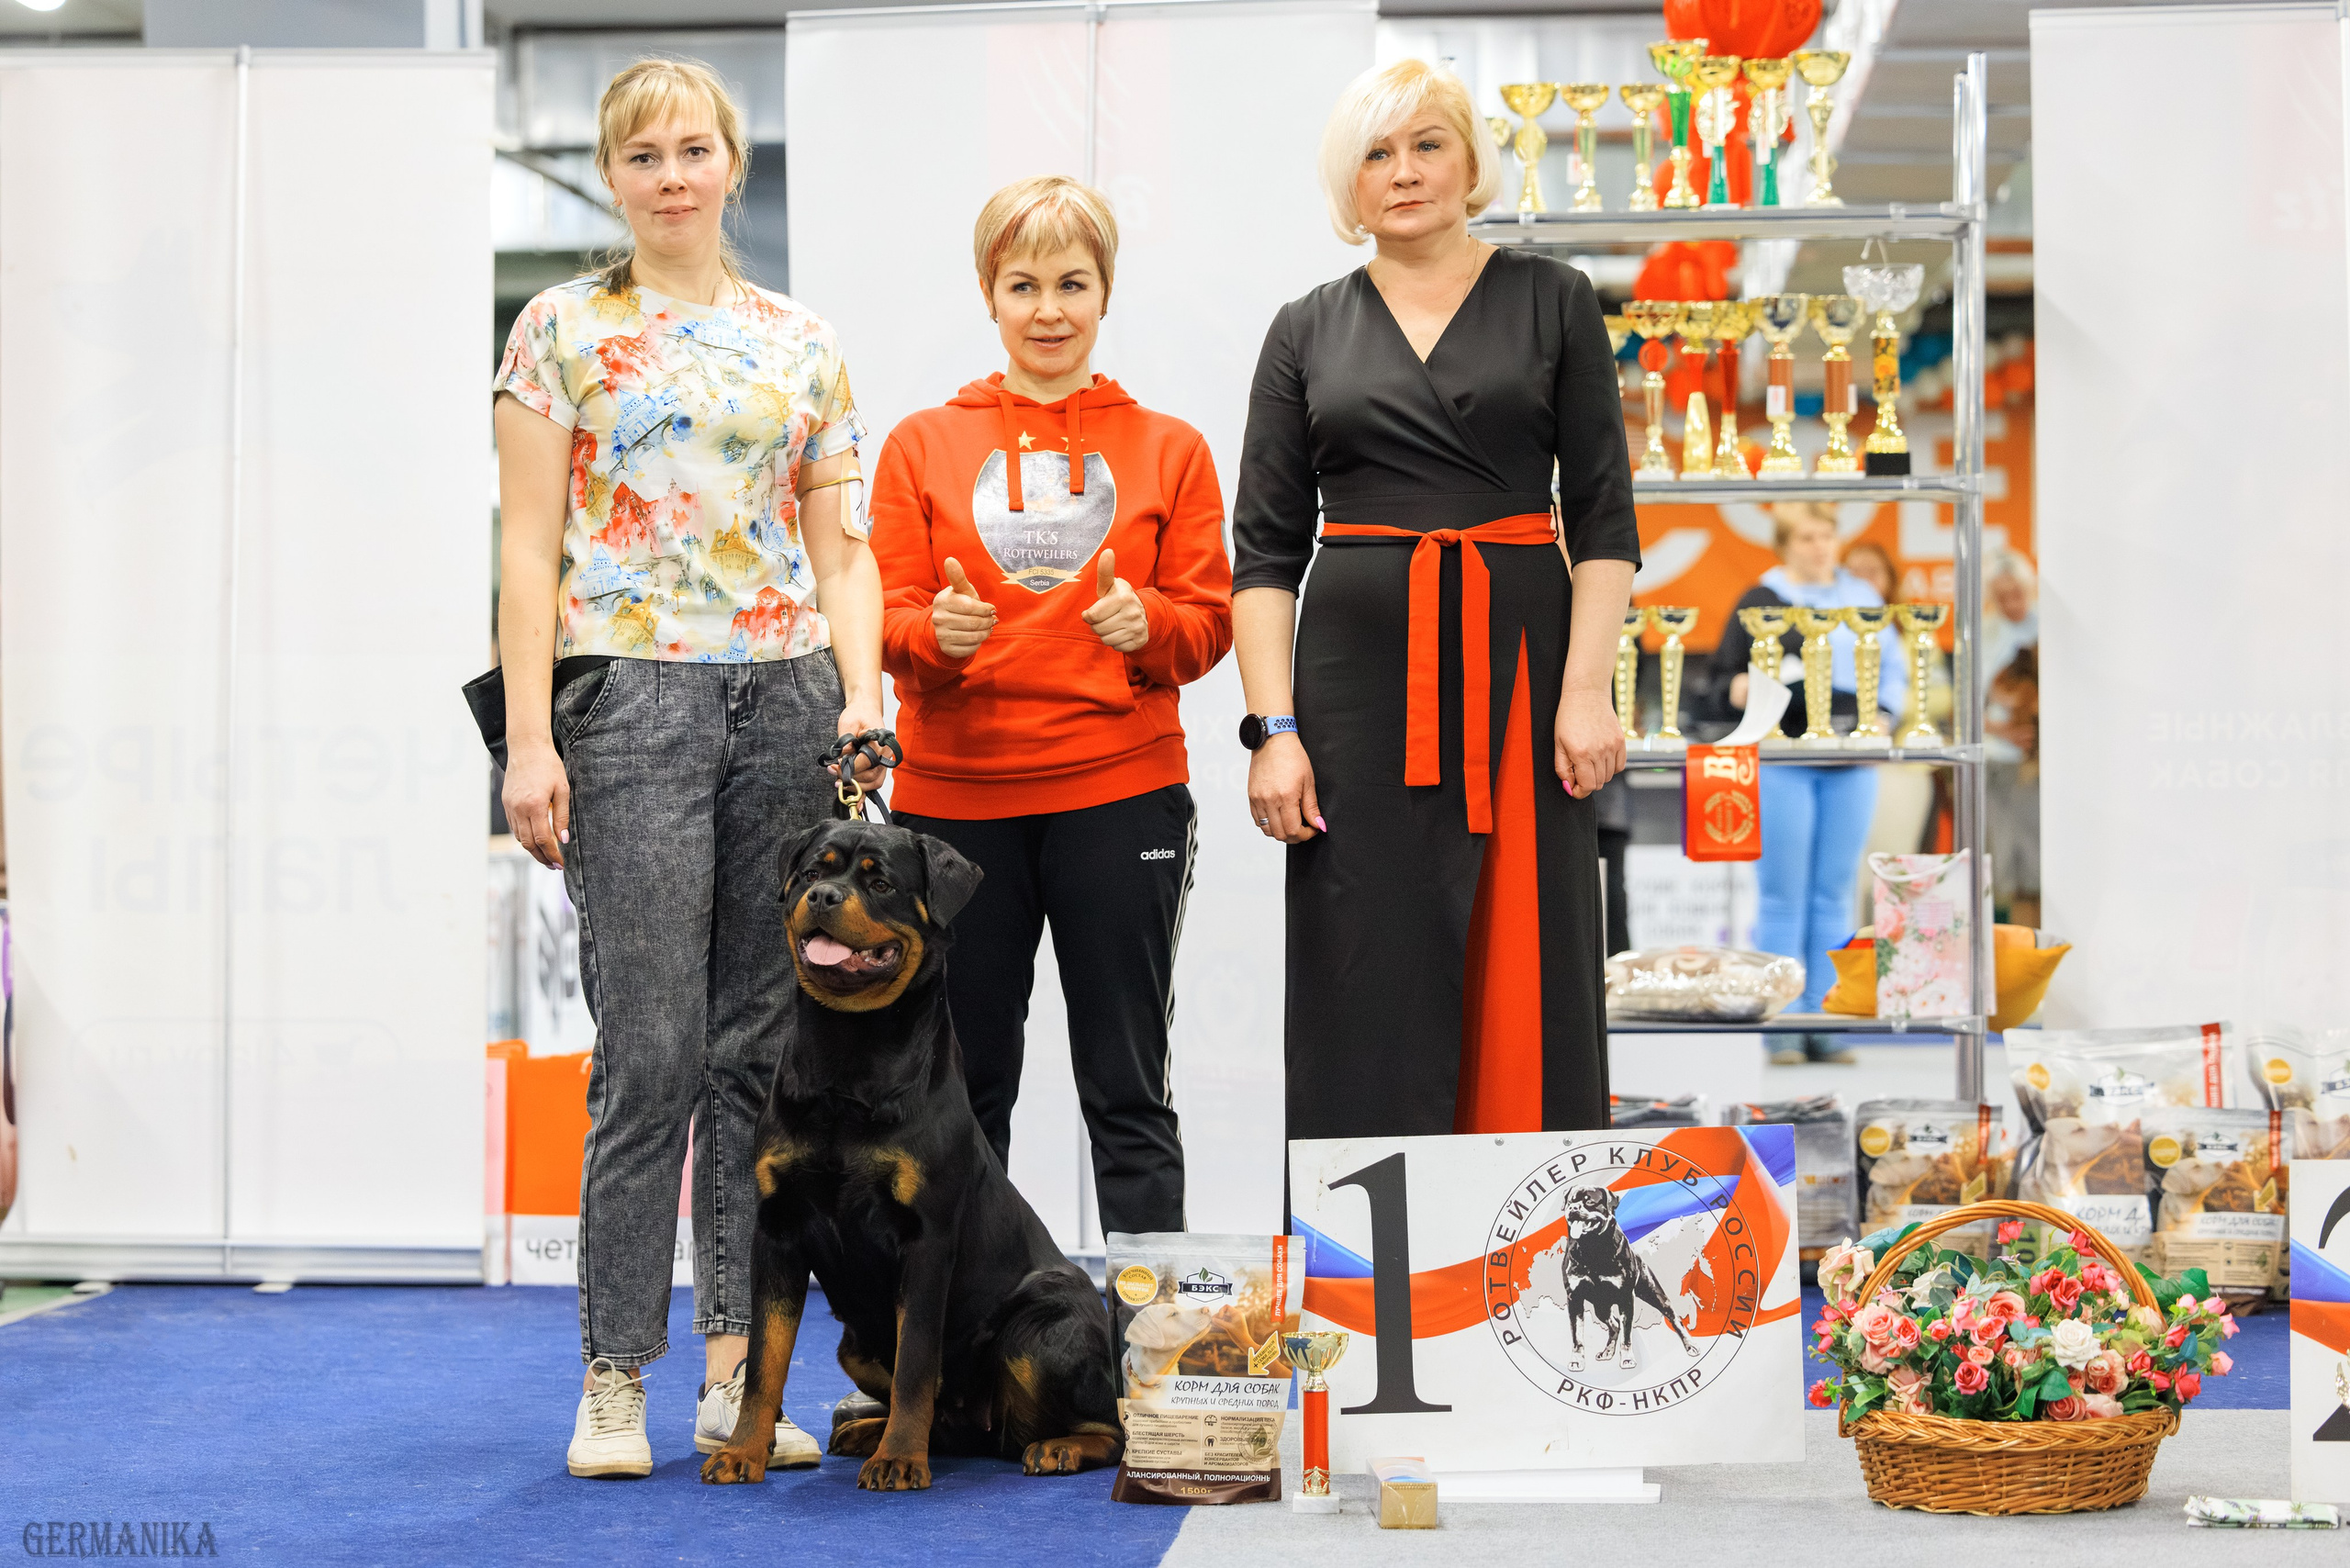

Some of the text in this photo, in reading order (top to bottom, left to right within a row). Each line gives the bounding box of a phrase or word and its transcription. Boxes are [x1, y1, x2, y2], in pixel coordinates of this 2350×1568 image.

[1024, 530, 1058, 544] TK'S
[1003, 547, 1079, 560] ROTTWEILERS
[1029, 578, 1050, 588] Serbia
[1140, 848, 1176, 860] adidas
[1489, 1147, 1755, 1346] РОТВЕЙЛЕР КЛУБ РОССИИ
[1191, 1284, 1219, 1293] БЭКС
[1327, 1152, 1453, 1415] 1
[1274, 1288, 1283, 1316] ЛУЧШЕЕ
[1174, 1380, 1280, 1396] КОРМ ДЛЯ СОБАК
[1557, 1368, 1703, 1412] РКФ-НКПР
[1170, 1396, 1280, 1409] КРУПНЫХ И СРЕДНИХ ПОРОД
[1126, 1471, 1203, 1482] АЛАНСИРОВАННЫЙ,
[1181, 1486, 1213, 1495] 1500г
